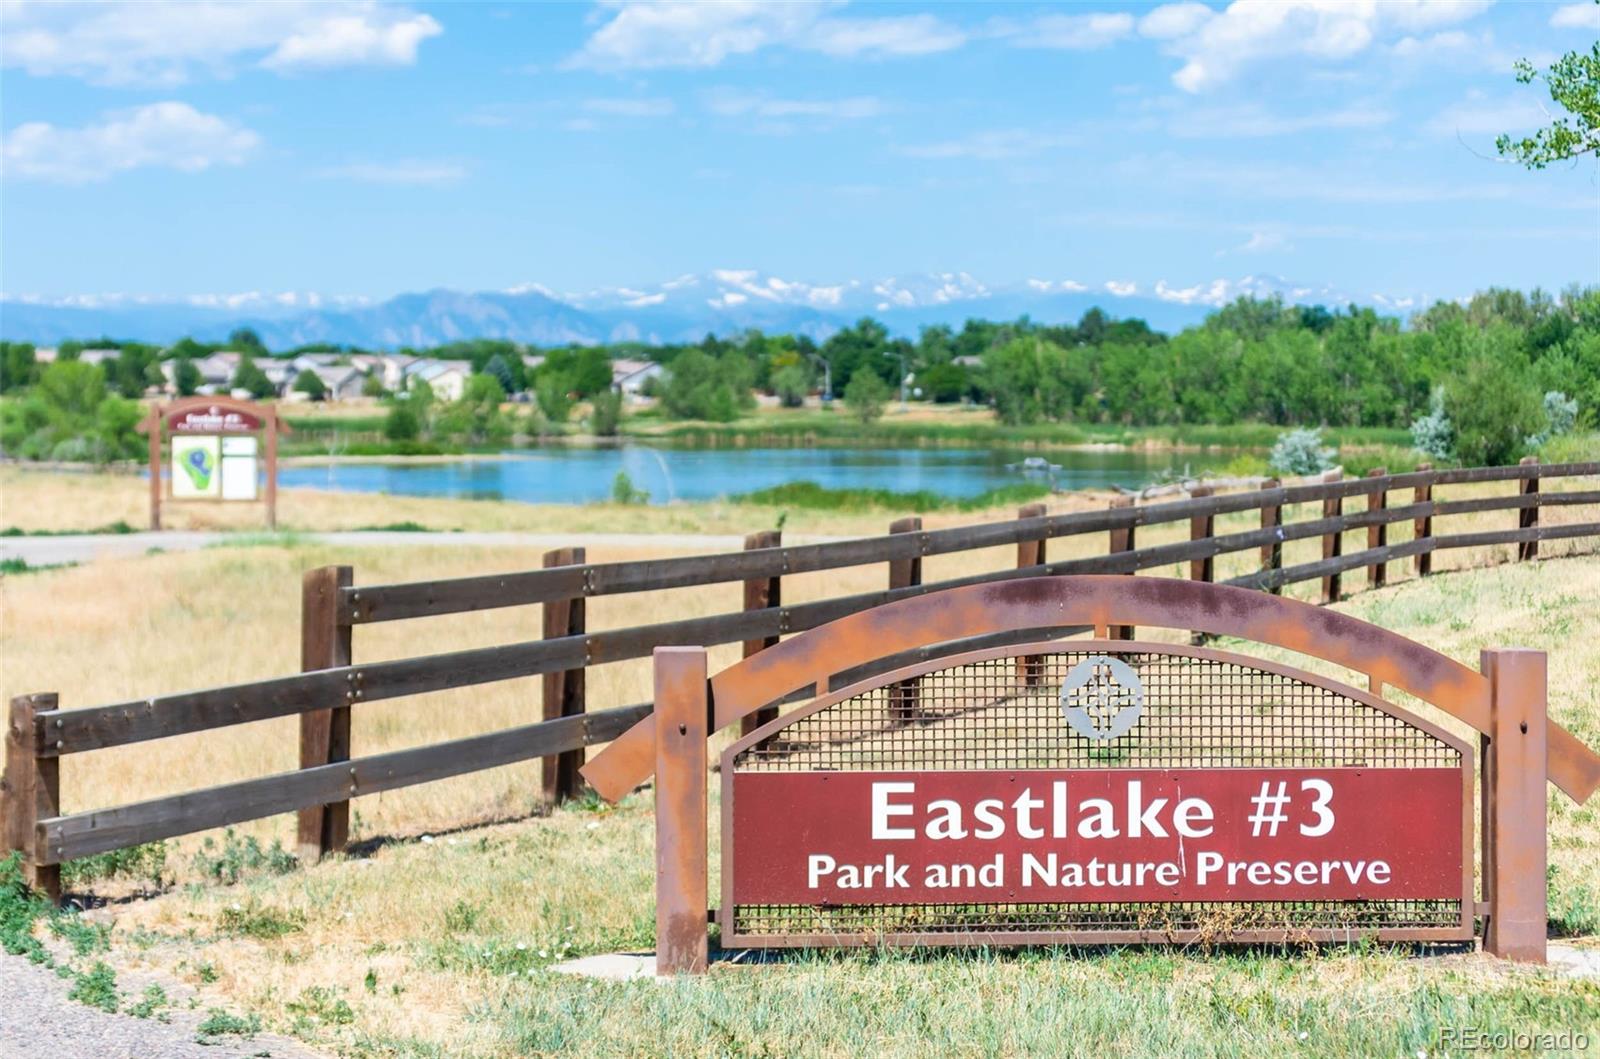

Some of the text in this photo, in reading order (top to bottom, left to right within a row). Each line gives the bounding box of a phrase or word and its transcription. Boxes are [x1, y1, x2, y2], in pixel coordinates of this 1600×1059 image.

[871, 778, 1335, 840] Eastlake #3
[807, 851, 1392, 889] Park and Nature Preserve
